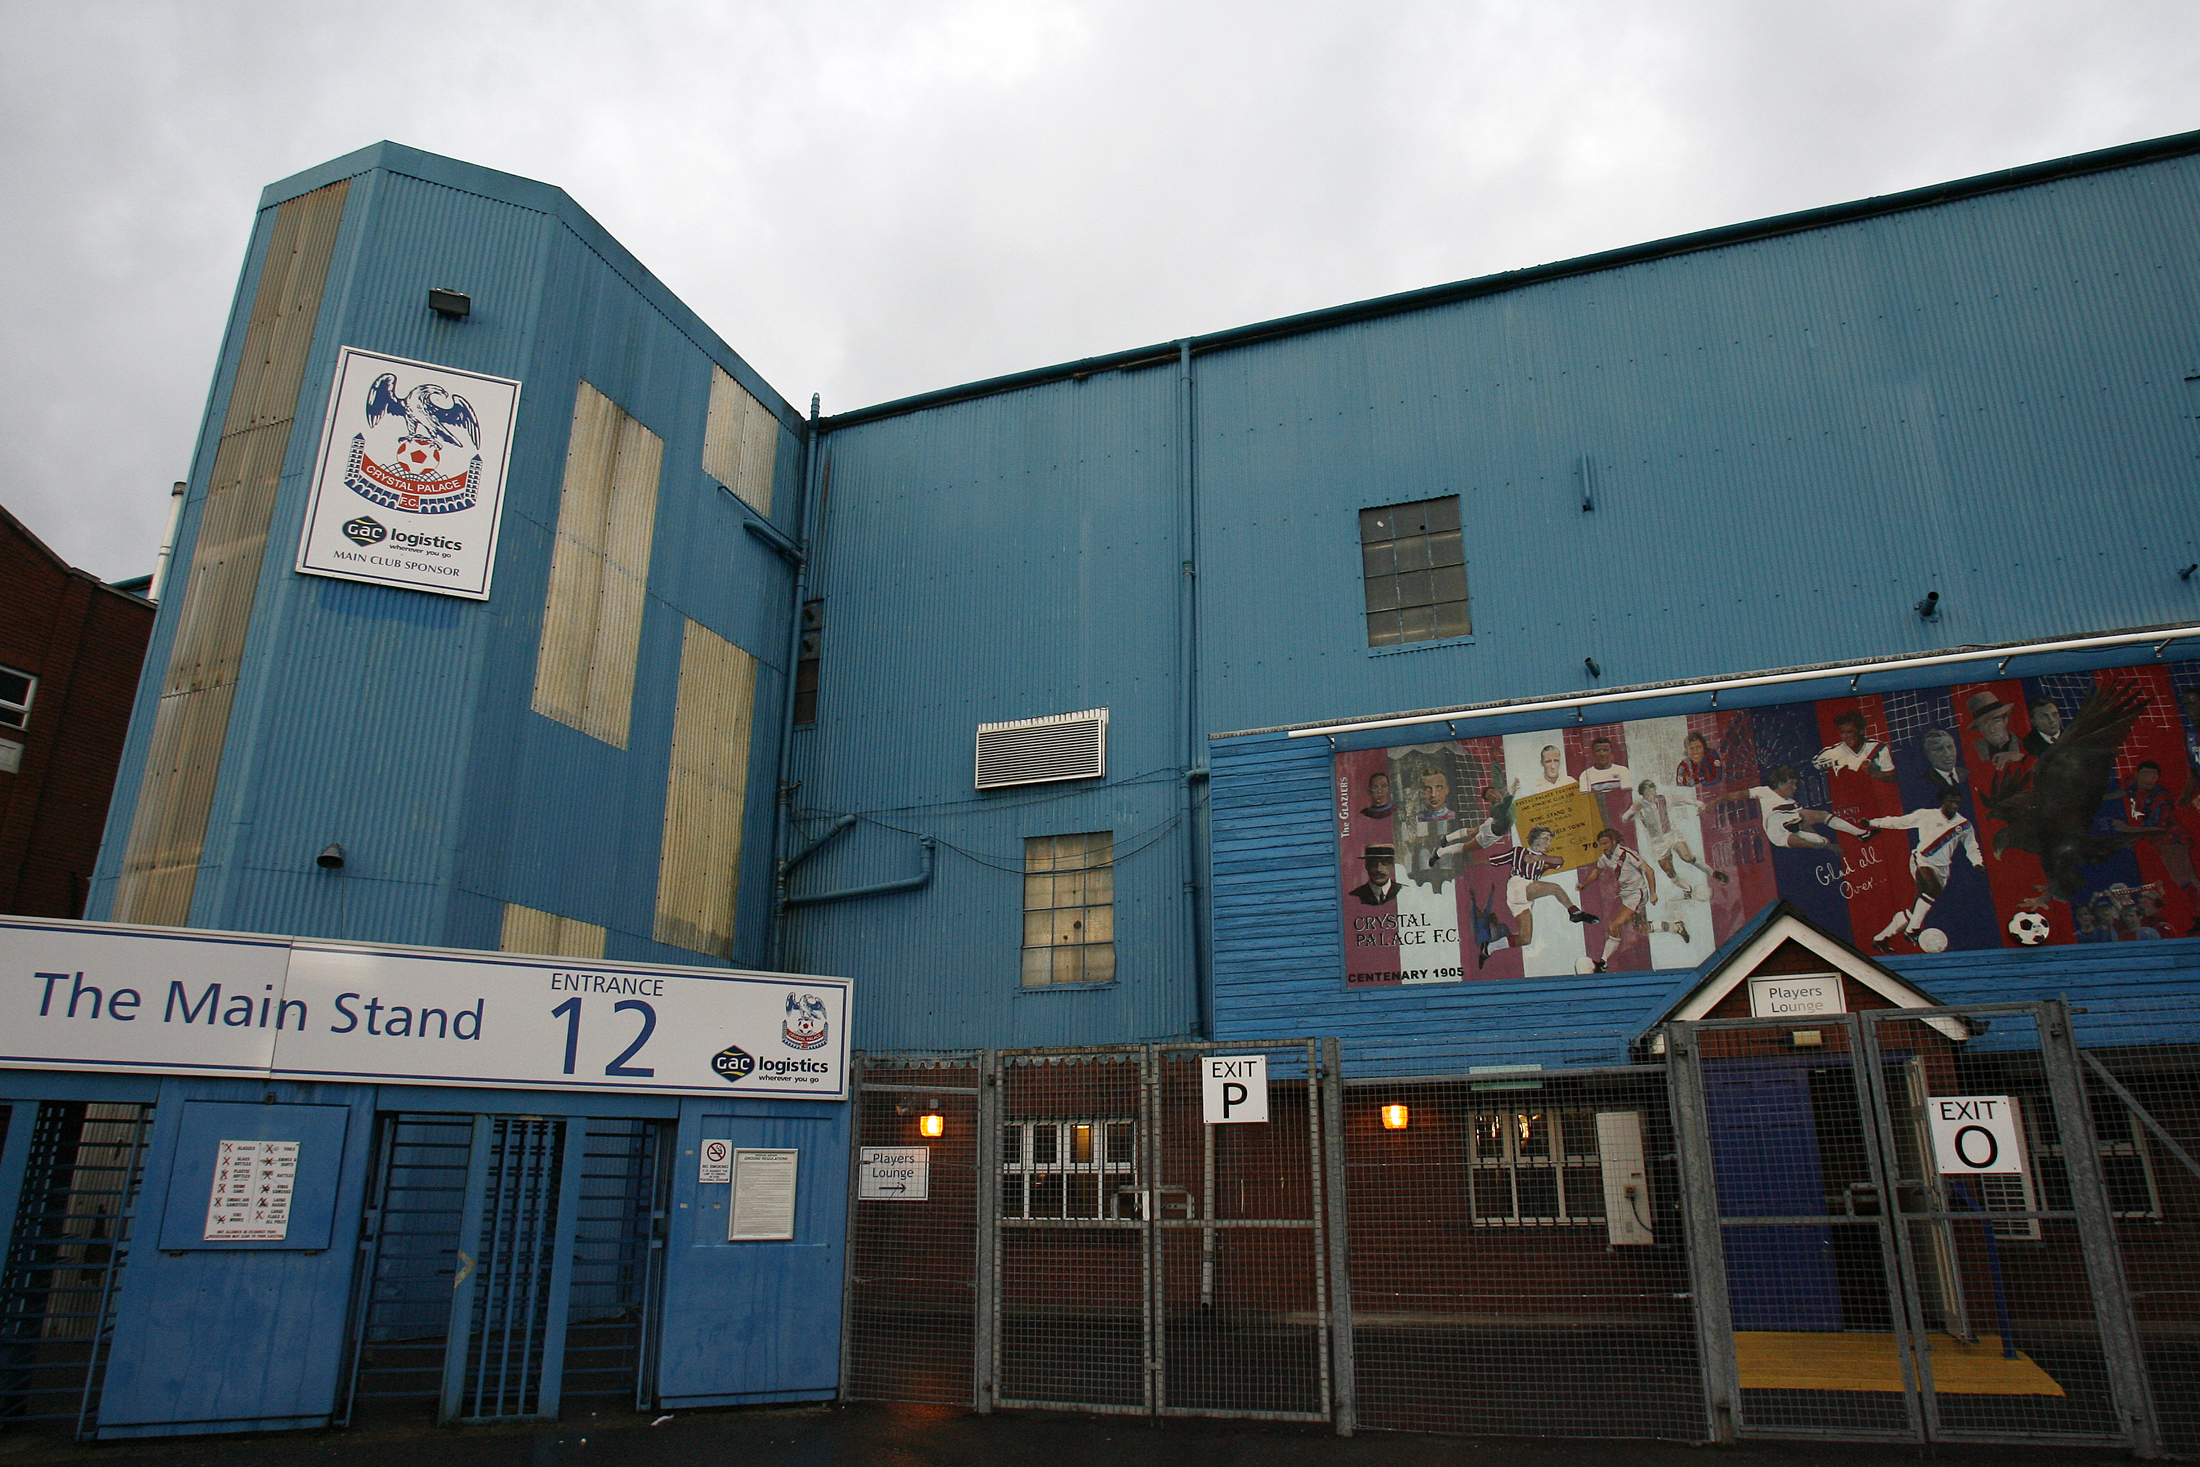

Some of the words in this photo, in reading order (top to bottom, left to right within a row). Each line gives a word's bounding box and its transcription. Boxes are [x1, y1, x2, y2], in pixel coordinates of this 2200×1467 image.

[366, 464, 414, 492] CRYSTAL
[417, 479, 461, 493] PALACE
[390, 528, 463, 552] logistics
[389, 544, 424, 554] wherever
[426, 549, 440, 558] you
[442, 551, 452, 559] go
[333, 550, 367, 563] MAIN
[370, 556, 402, 568] CLUB
[404, 561, 461, 577] SPONSOR
[1339, 776, 1349, 820] GLAZIERS
[1341, 821, 1350, 838] The
[1815, 856, 1856, 886] Glad
[1859, 846, 1884, 868] all
[1353, 913, 1431, 932] CRYSTAL
[1355, 930, 1426, 948] PALACE
[1433, 929, 1461, 944] F.C.
[1348, 969, 1429, 983] CENTENARY
[1432, 967, 1464, 978] 1905
[550, 972, 665, 998] ENTRANCE
[1769, 987, 1822, 1000] Players
[34, 971, 142, 1022] The
[163, 980, 309, 1033] Main
[330, 992, 486, 1042] Stand
[1771, 1001, 1824, 1014] Lounge
[550, 996, 659, 1078] 12
[758, 1056, 829, 1075] logistics
[1211, 1061, 1257, 1078] EXIT
[758, 1074, 792, 1082] wherever
[794, 1076, 807, 1084] you
[1222, 1082, 1248, 1119] P
[1939, 1100, 1999, 1121] EXIT
[1953, 1124, 1999, 1169] O
[873, 1153, 915, 1166] Players
[872, 1168, 914, 1181] Lounge
